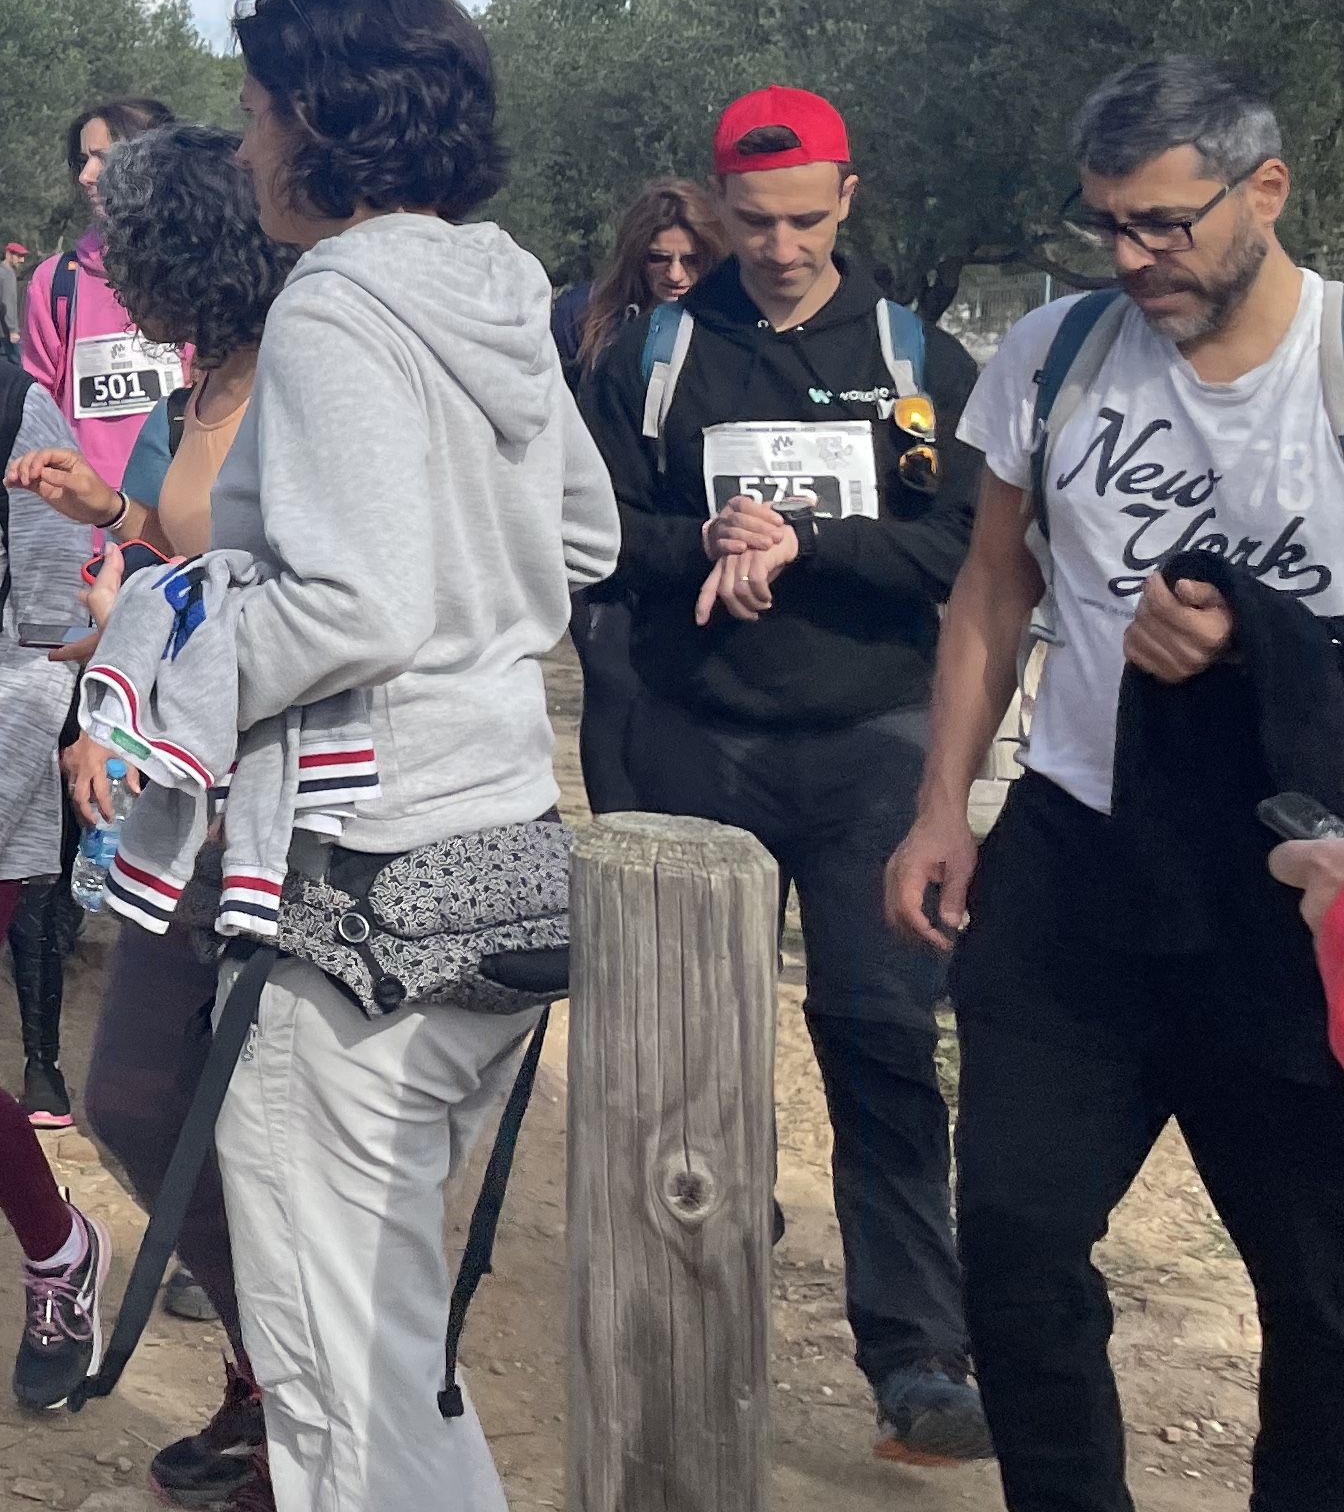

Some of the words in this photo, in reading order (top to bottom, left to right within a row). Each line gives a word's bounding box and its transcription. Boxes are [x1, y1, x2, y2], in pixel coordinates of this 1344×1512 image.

[93, 372, 146, 401] 501
[1056, 407, 1222, 508] New
[738, 476, 818, 505] 575
[1108, 503, 1332, 598] York
